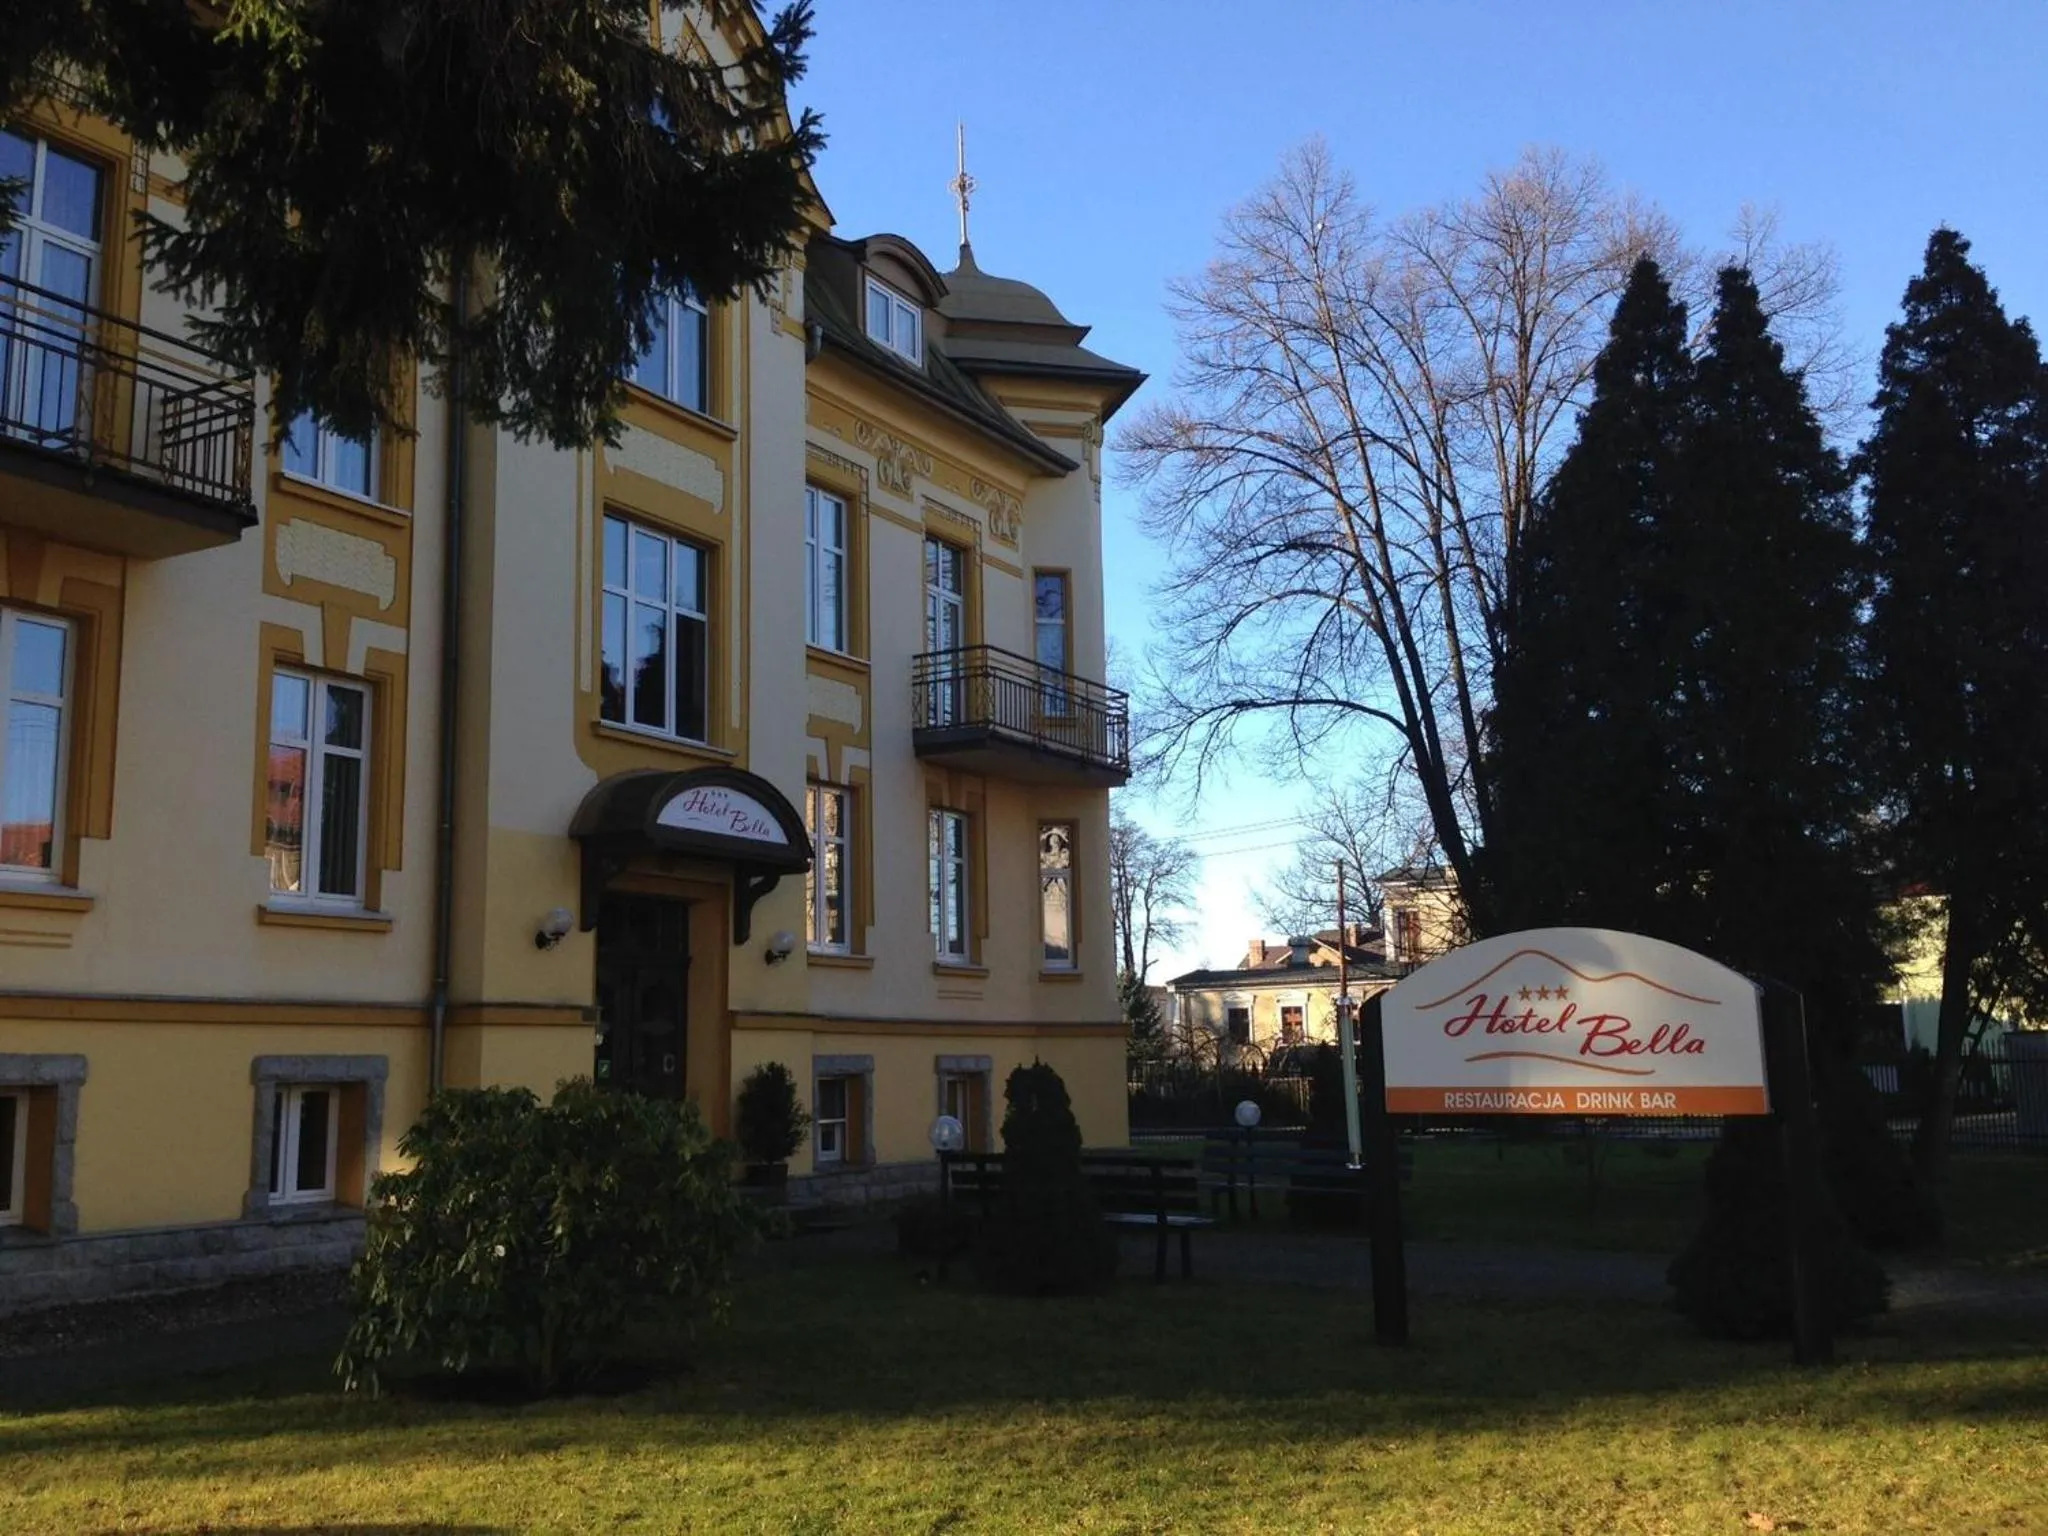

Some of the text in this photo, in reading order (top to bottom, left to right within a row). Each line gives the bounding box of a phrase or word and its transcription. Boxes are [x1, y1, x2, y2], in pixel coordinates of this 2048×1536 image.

[683, 790, 770, 837] Hotel Bella
[1444, 993, 1705, 1056] Hotel Bella
[1444, 1091, 1677, 1110] RESTAURACJA DRINK BAR
